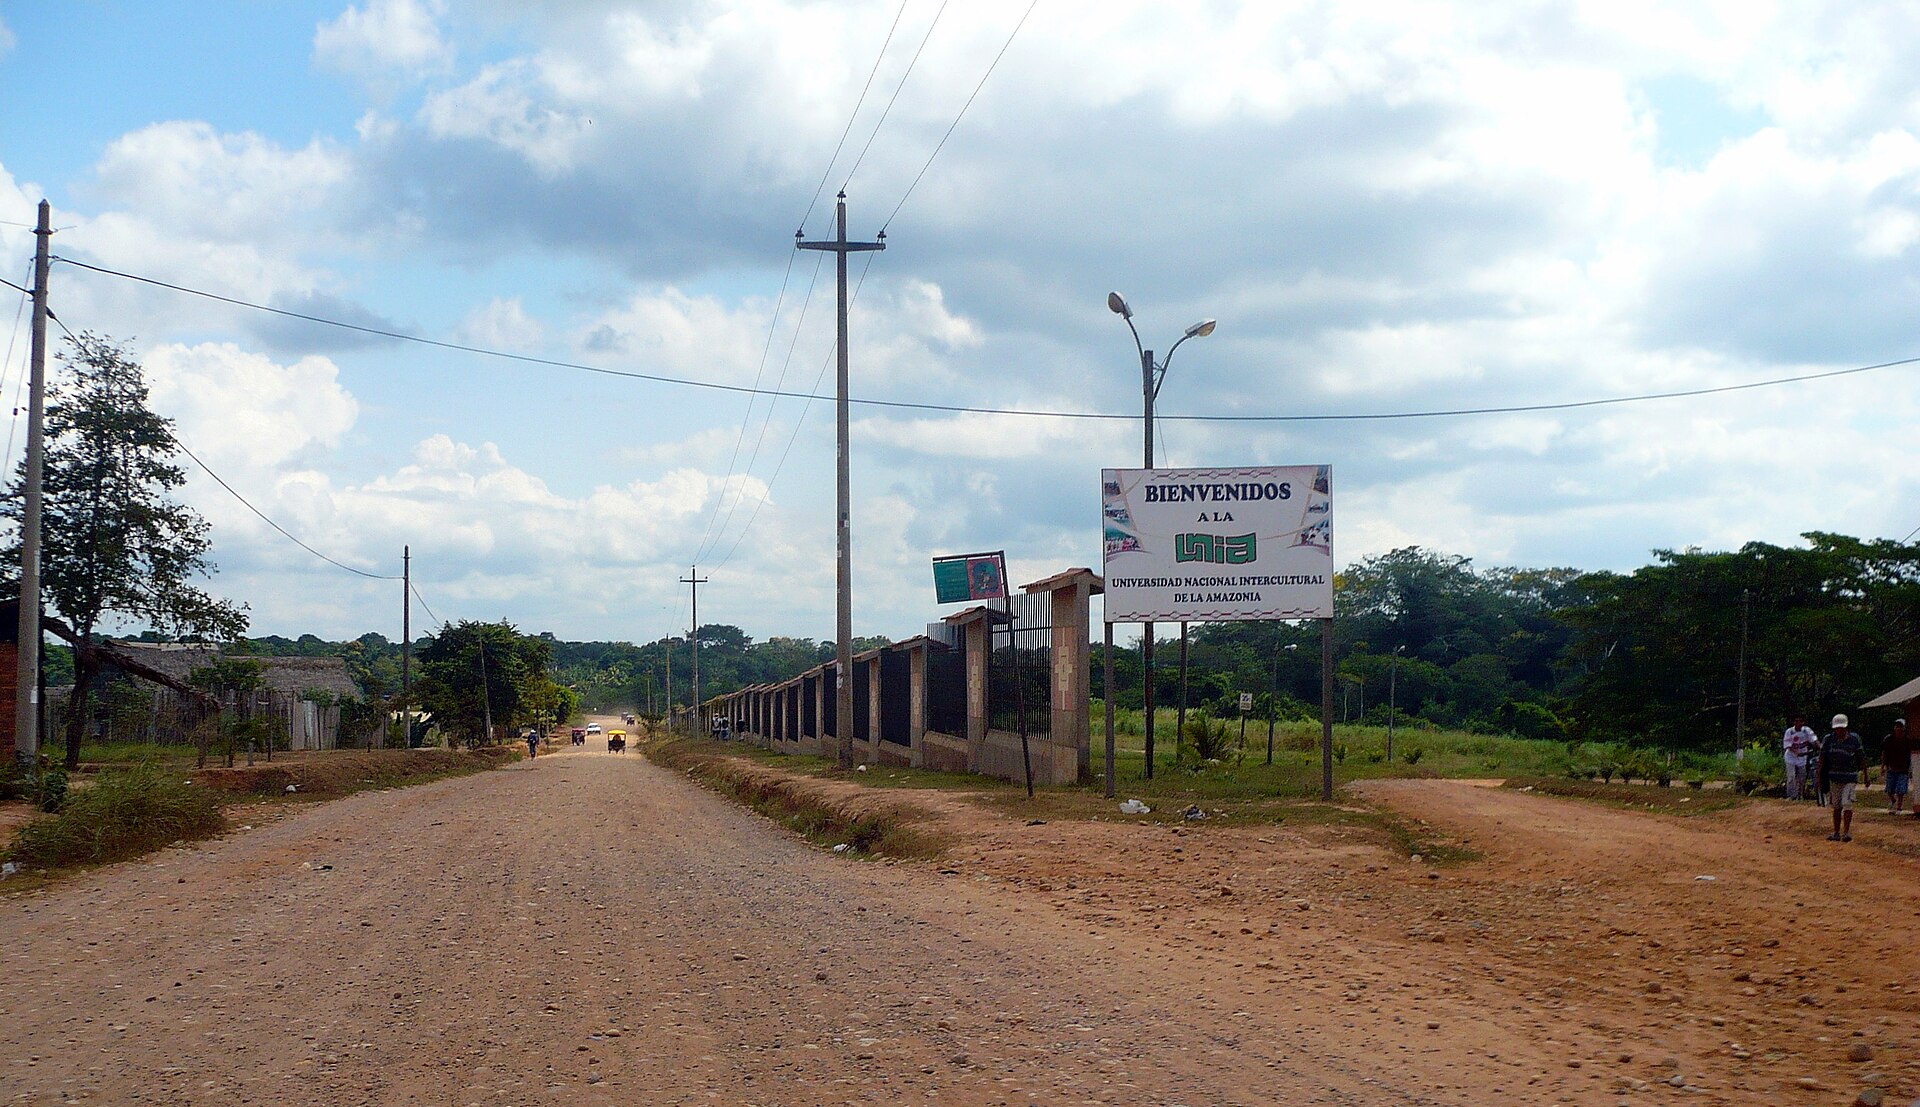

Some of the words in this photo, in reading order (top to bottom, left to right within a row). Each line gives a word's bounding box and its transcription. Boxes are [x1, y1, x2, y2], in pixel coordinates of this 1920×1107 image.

[1145, 482, 1291, 502] BIENVENIDOS
[1197, 512, 1209, 522] A
[1213, 511, 1234, 522] LA
[1112, 576, 1182, 588] UNIVERSIDAD
[1184, 576, 1238, 587] NACIONAL
[1239, 575, 1325, 586] INTERCULTURAL
[1174, 593, 1188, 603] DE
[1190, 593, 1204, 603] LA
[1205, 592, 1261, 602] AMAZONIA
